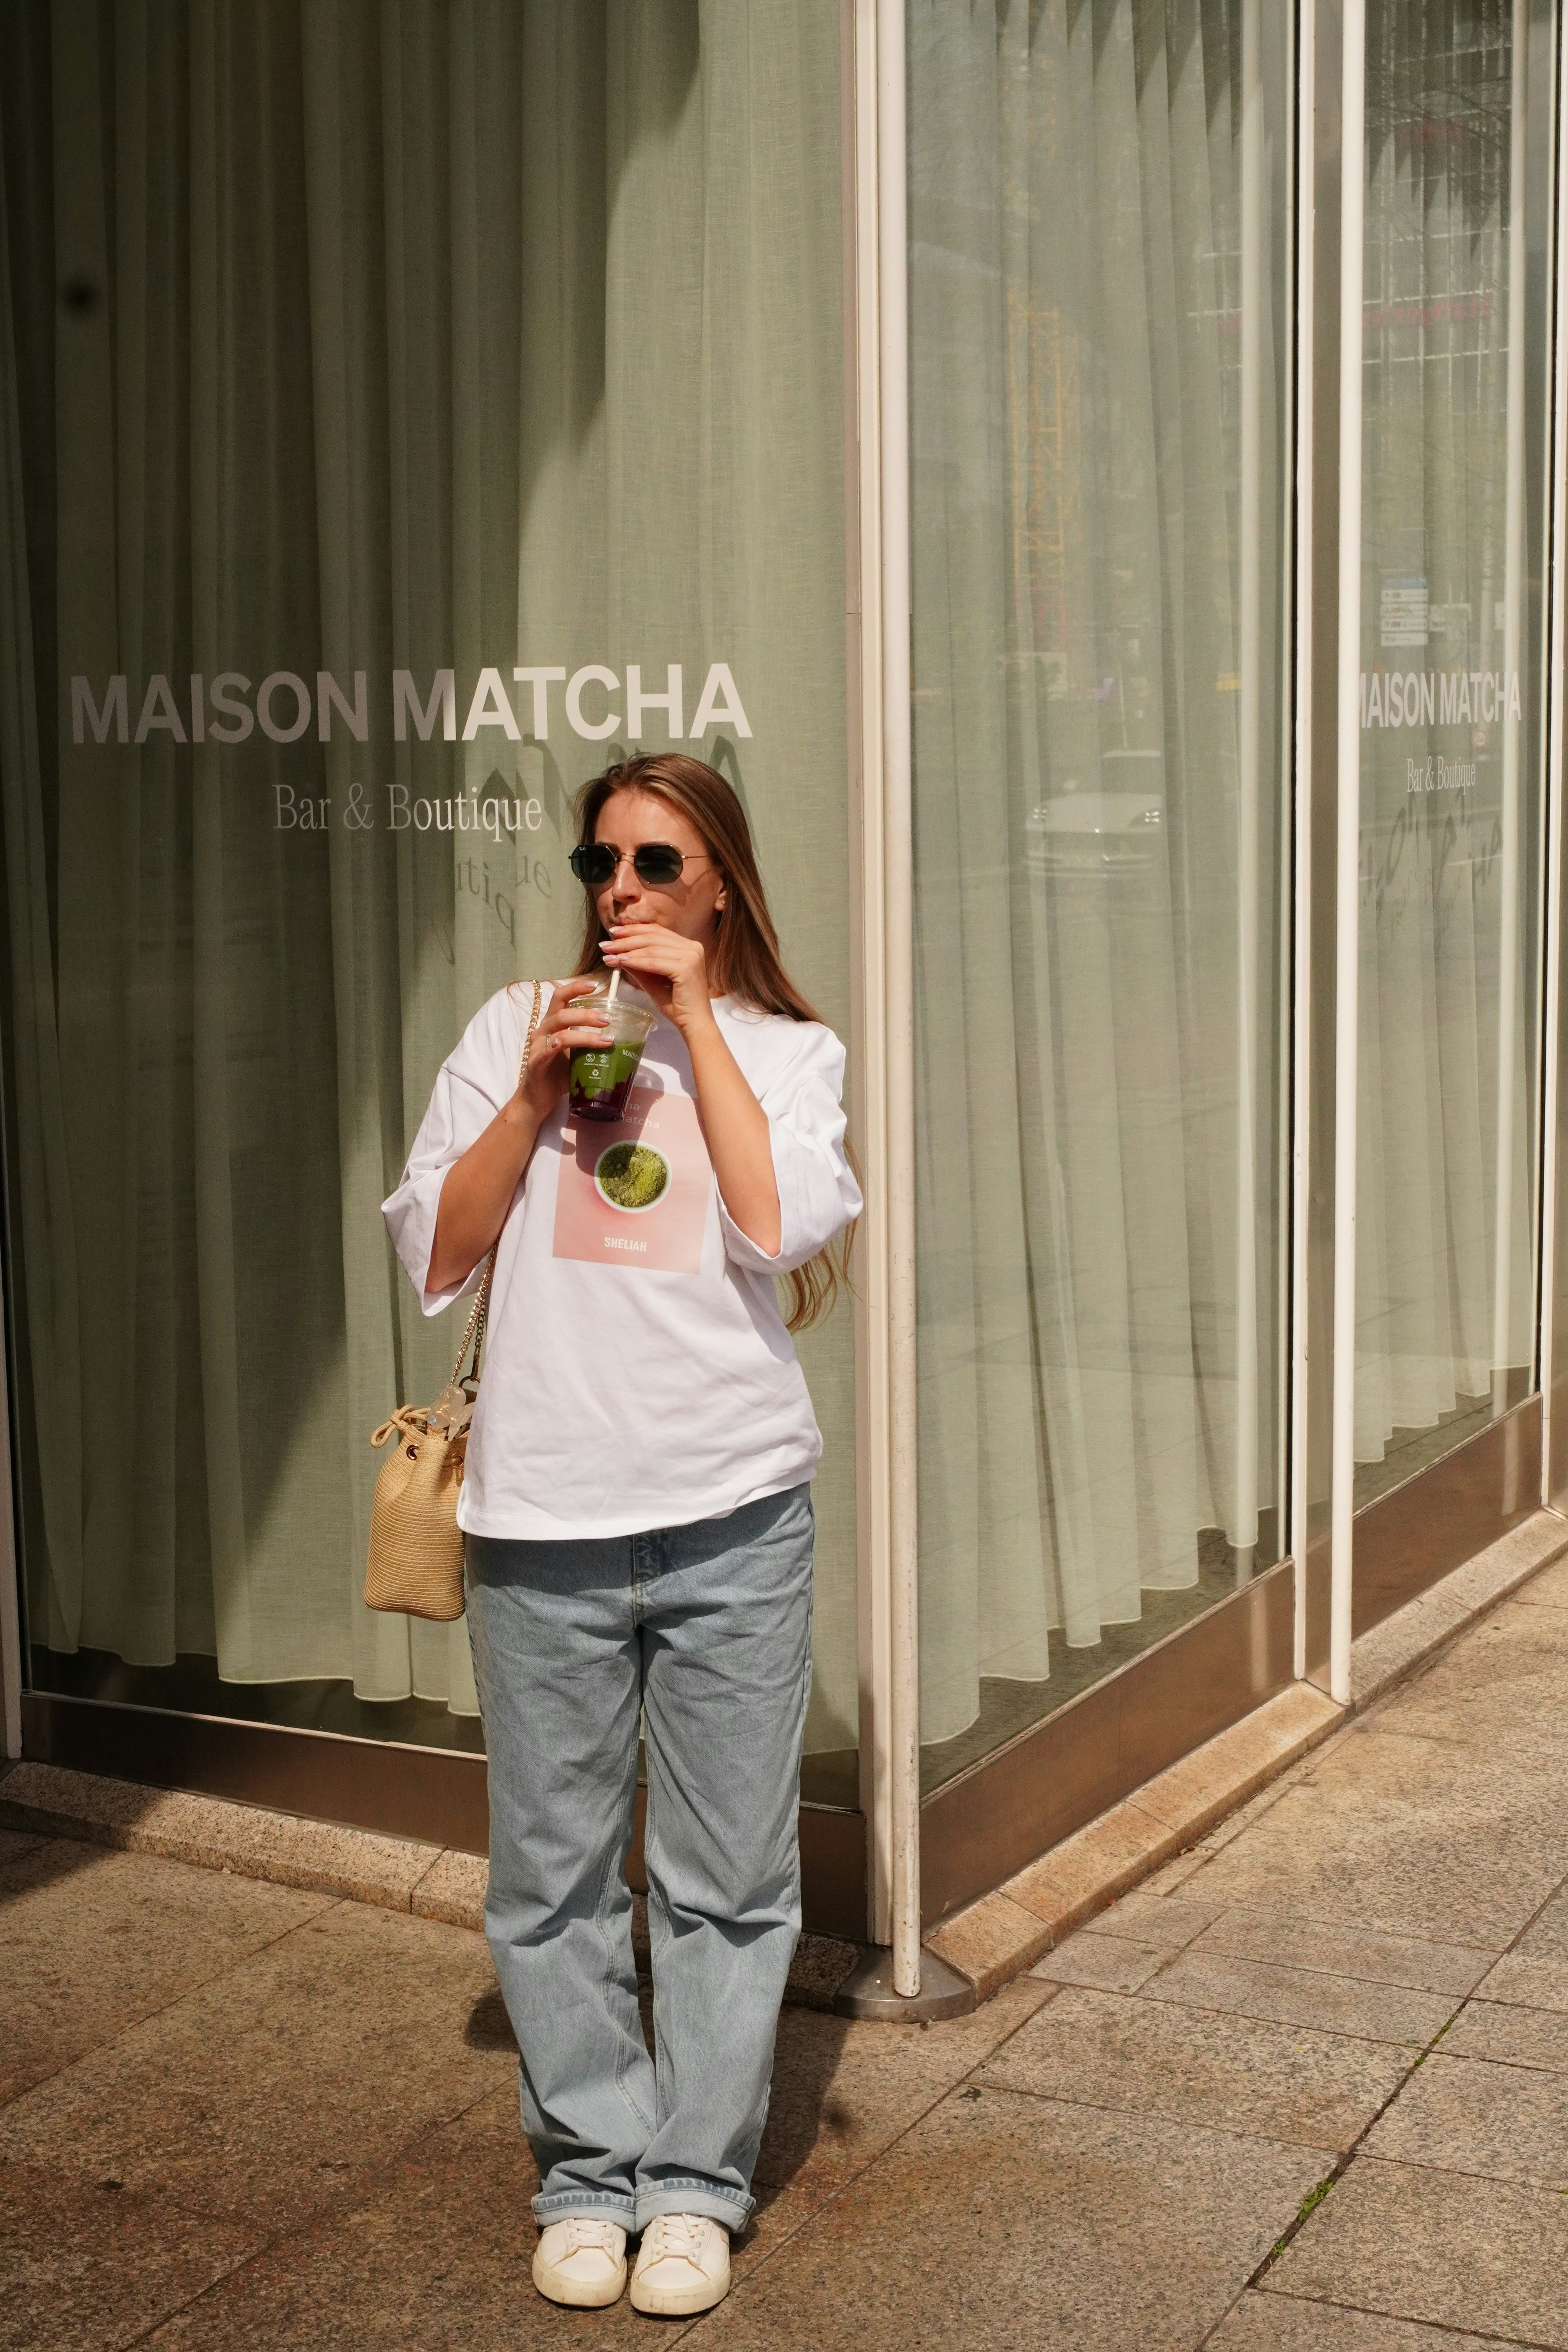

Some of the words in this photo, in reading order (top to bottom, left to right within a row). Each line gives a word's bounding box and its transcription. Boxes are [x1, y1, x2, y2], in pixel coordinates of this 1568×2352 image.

[70, 671, 368, 744] MAISON
[394, 663, 753, 740] MATCHA
[1440, 671, 1521, 725] MATCHA
[1406, 758, 1423, 793] Bar
[1426, 756, 1434, 791] &
[1437, 756, 1475, 795] Boutique
[272, 784, 331, 830] Bar
[343, 783, 374, 830] &
[385, 784, 542, 843] Boutique
[626, 1116, 660, 1129] atcha
[604, 1237, 647, 1252] SHELIAH
